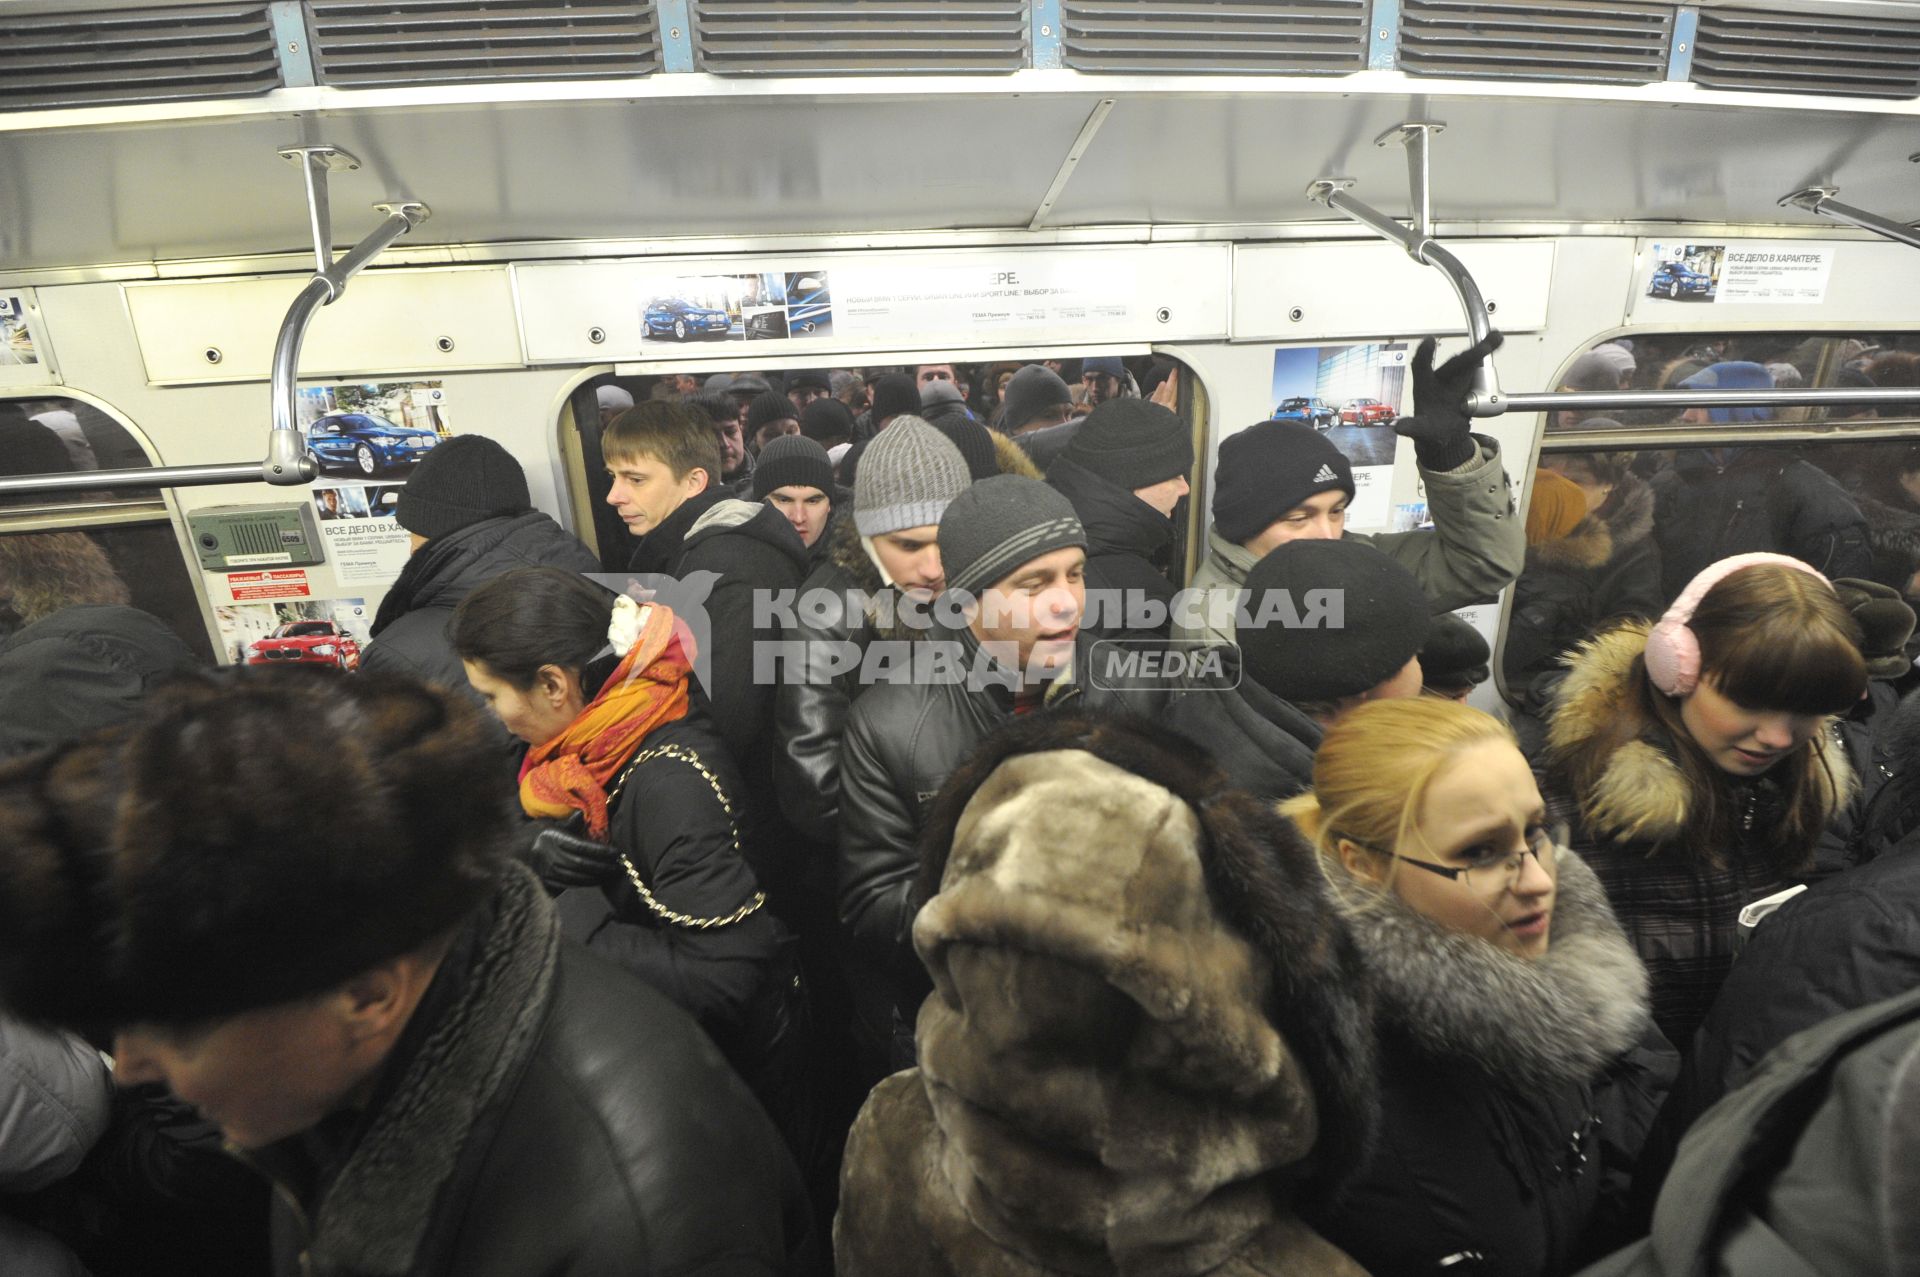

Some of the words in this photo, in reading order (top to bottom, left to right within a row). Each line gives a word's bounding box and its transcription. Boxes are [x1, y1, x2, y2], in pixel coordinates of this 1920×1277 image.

[1728, 253, 1745, 262] ВСЕ
[1745, 253, 1768, 263] ДЕЛО
[1769, 254, 1775, 263] В
[1776, 254, 1822, 263] ХАРАКТЕРЕ.
[1024, 288, 1049, 296] ВЫБОР
[325, 526, 347, 536] ВСЕ
[348, 524, 377, 536] ДЕЛО
[378, 523, 386, 533] В
